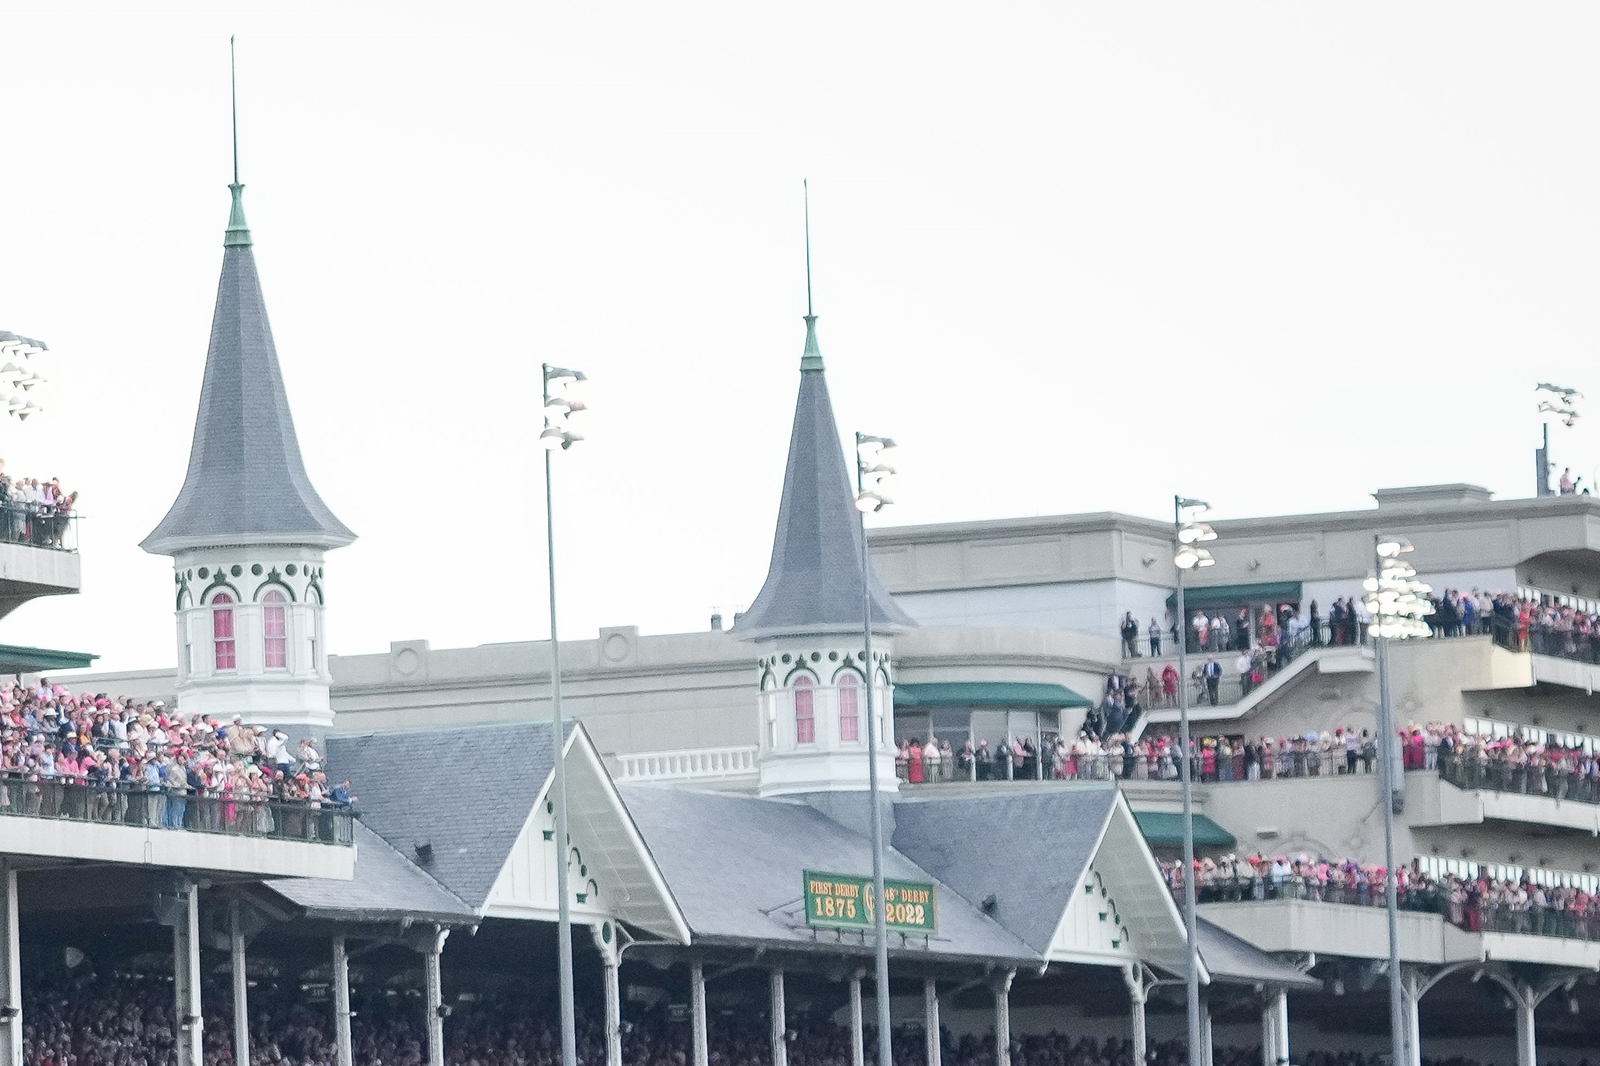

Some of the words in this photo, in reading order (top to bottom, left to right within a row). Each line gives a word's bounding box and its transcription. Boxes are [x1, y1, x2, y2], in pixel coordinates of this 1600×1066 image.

[809, 880, 833, 895] FIRST
[834, 883, 860, 898] DERBY
[901, 889, 930, 904] DERBY
[815, 897, 857, 919] 1875
[886, 902, 926, 926] 2022
